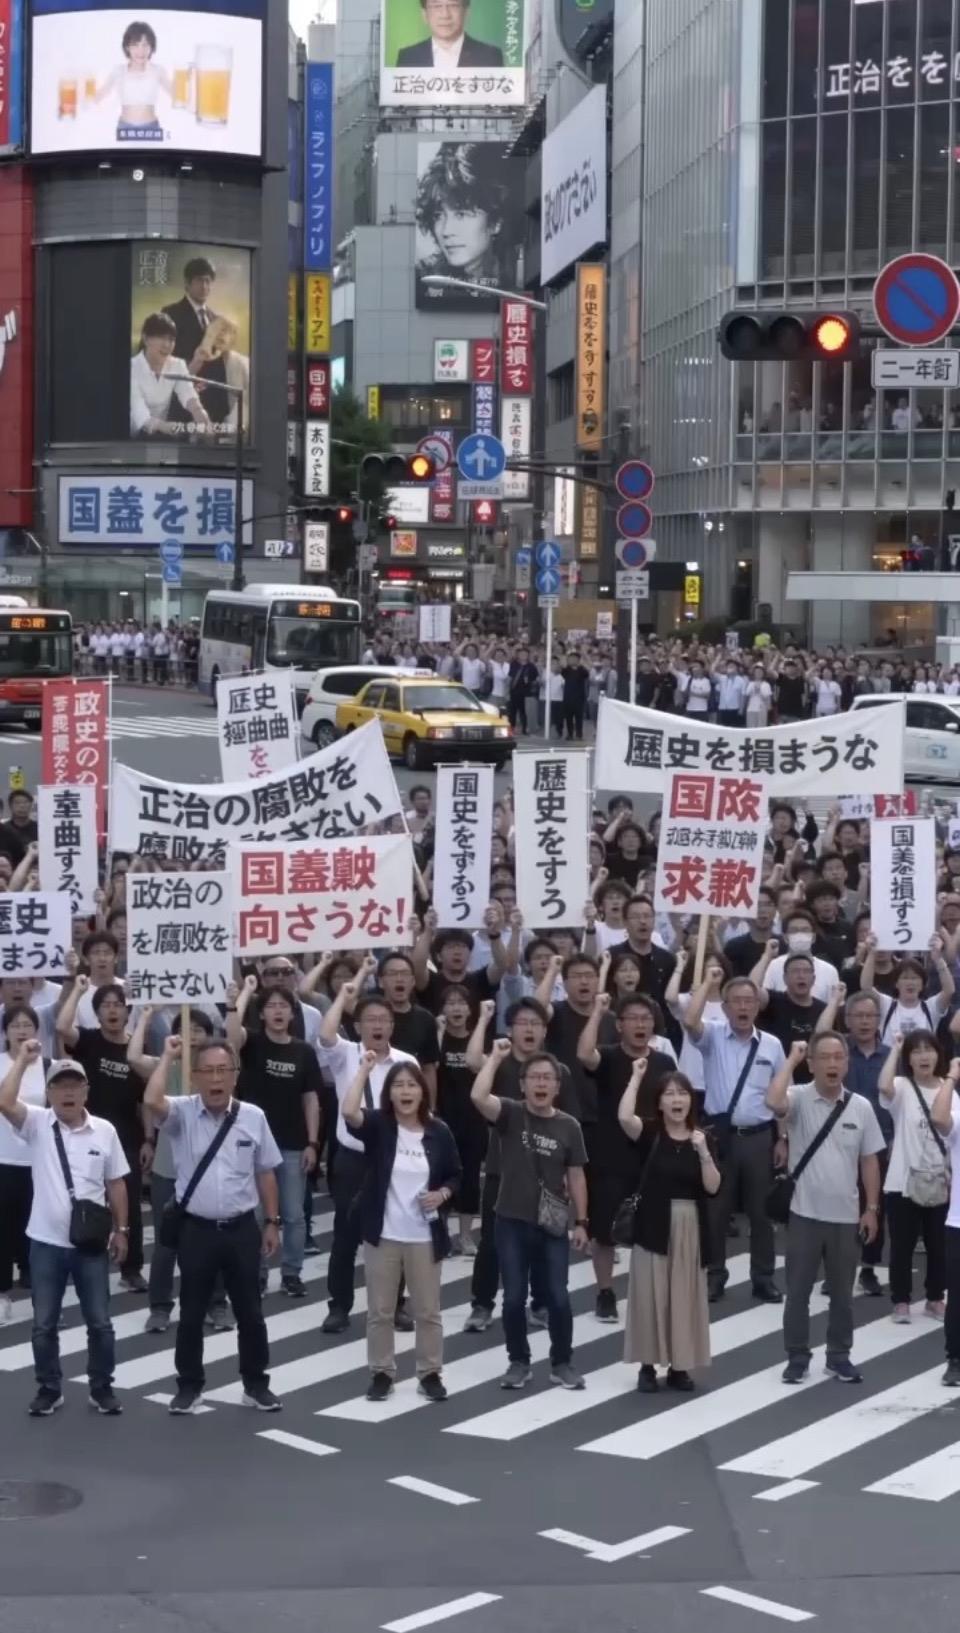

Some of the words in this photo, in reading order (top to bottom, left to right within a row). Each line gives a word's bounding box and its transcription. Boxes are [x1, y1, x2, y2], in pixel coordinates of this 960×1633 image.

[624, 726, 878, 775] 歴史を損まうな
[132, 877, 223, 909] 政治の
[132, 921, 229, 955] を腐敗を
[239, 897, 405, 948] 向さうな!
[130, 969, 226, 1000] 許さない
